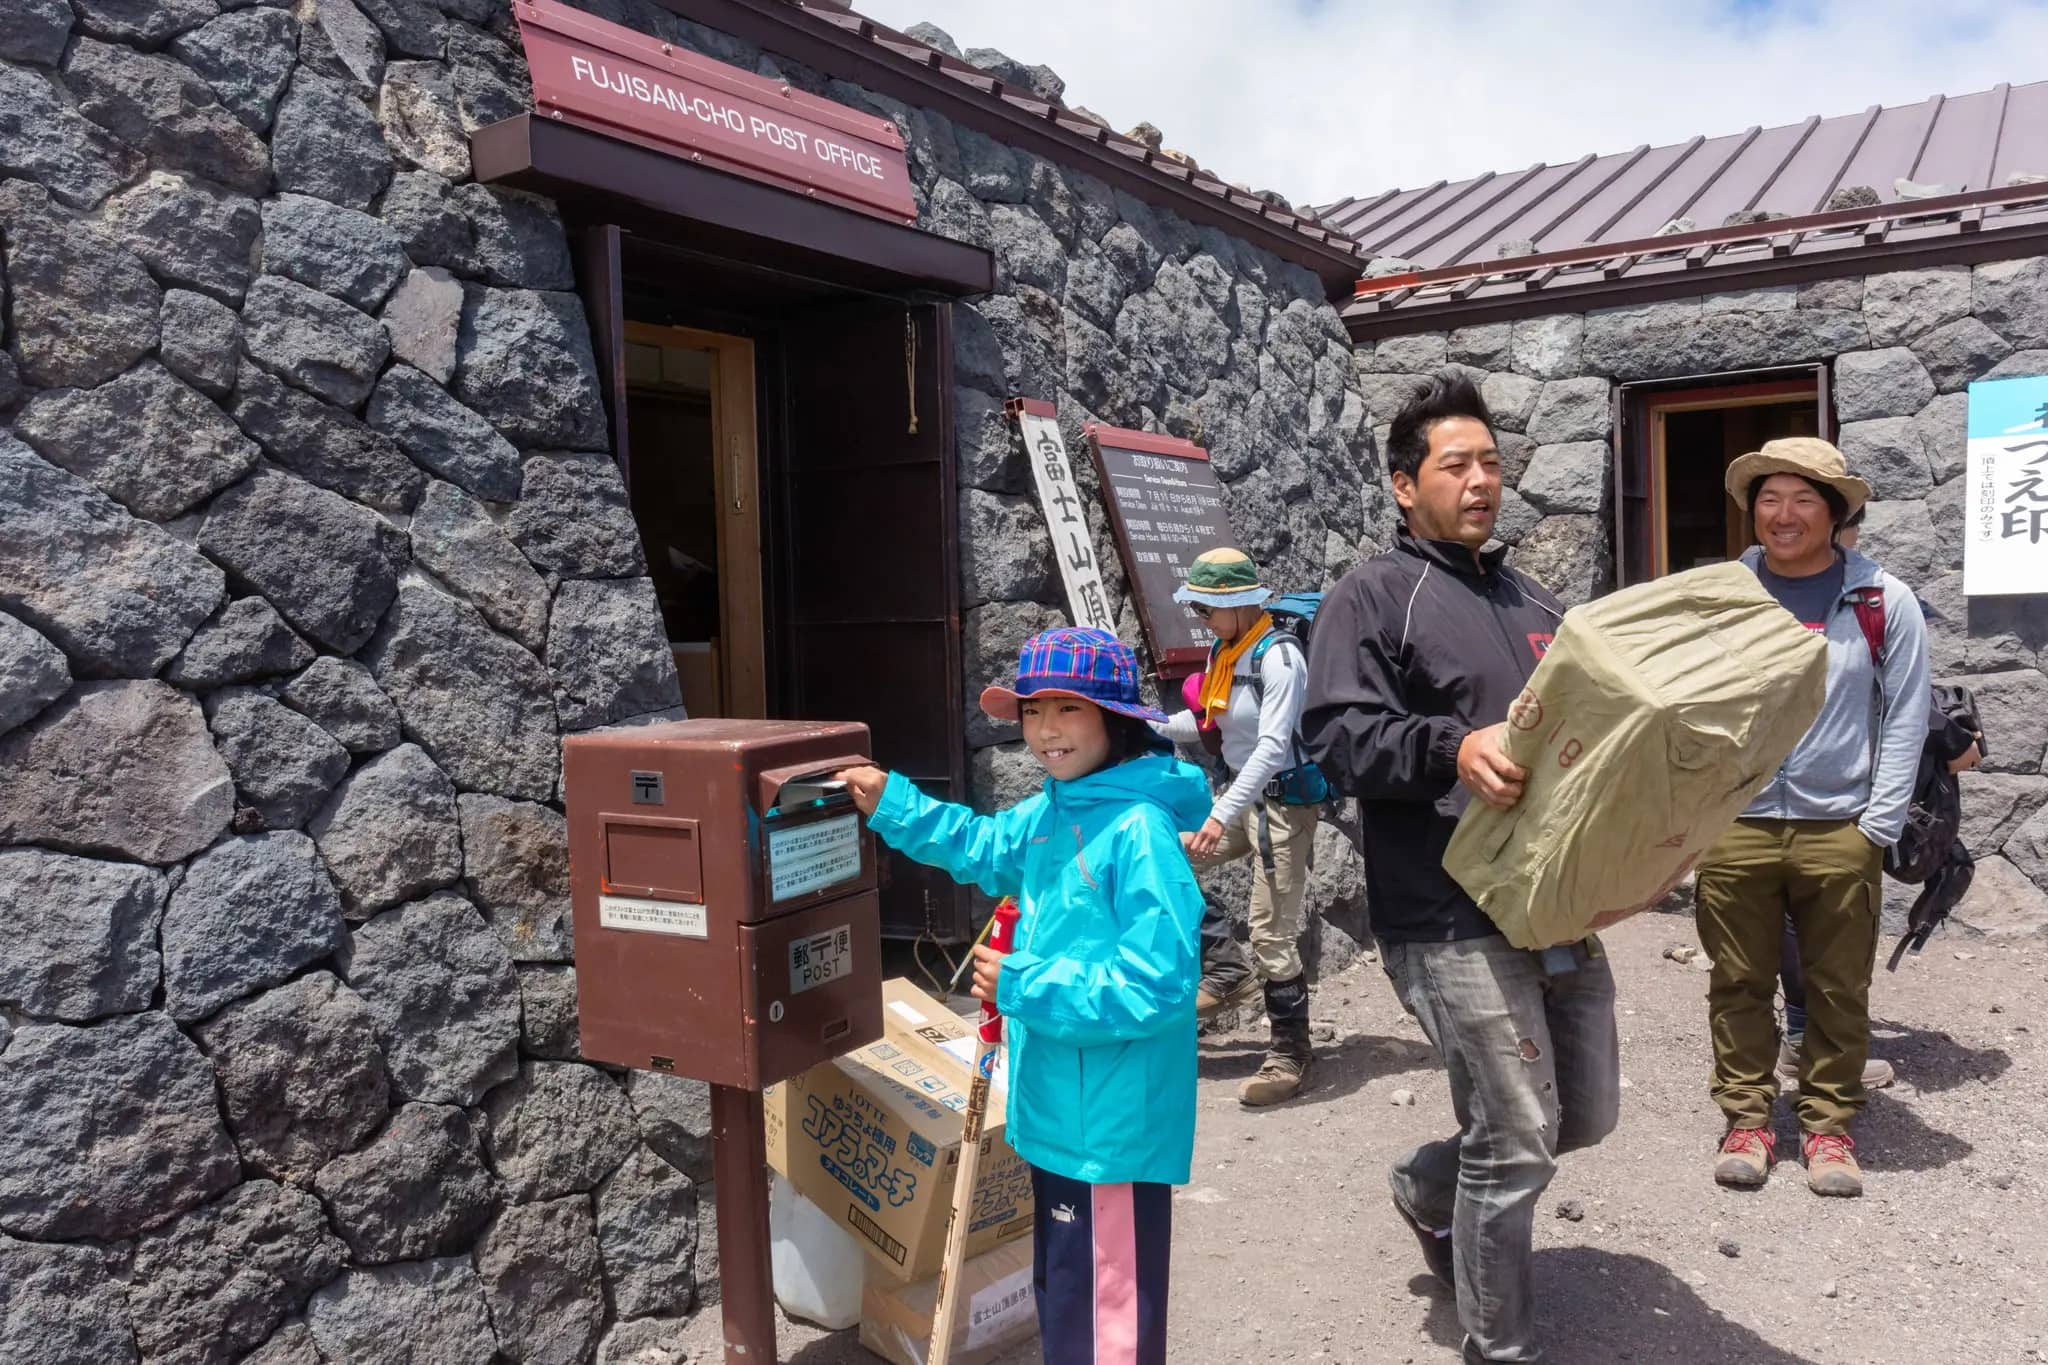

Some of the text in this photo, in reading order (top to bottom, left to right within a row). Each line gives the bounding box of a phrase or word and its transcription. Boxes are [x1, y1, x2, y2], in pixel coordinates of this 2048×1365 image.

[571, 55, 884, 179] FUJISAN-CHO POST OFFICE
[803, 958, 840, 984] POST
[849, 1089, 888, 1124] LOTTE
[802, 1094, 917, 1207] コアラのマーチ
